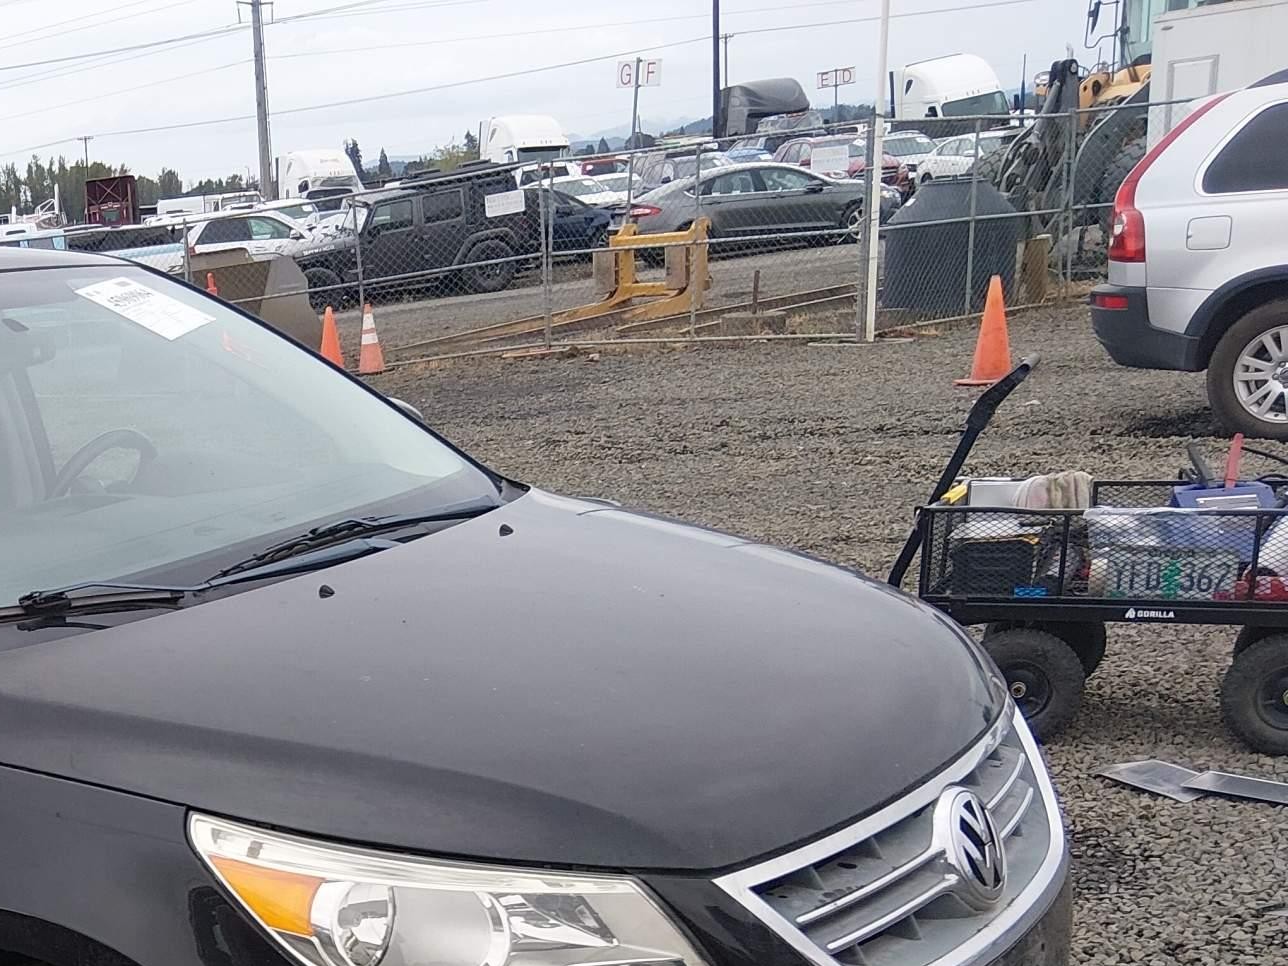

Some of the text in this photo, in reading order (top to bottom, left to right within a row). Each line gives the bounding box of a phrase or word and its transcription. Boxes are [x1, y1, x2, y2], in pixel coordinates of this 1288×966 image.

[620, 61, 657, 86] G F
[821, 69, 852, 87] E D
[1136, 610, 1175, 619] GORILLA
